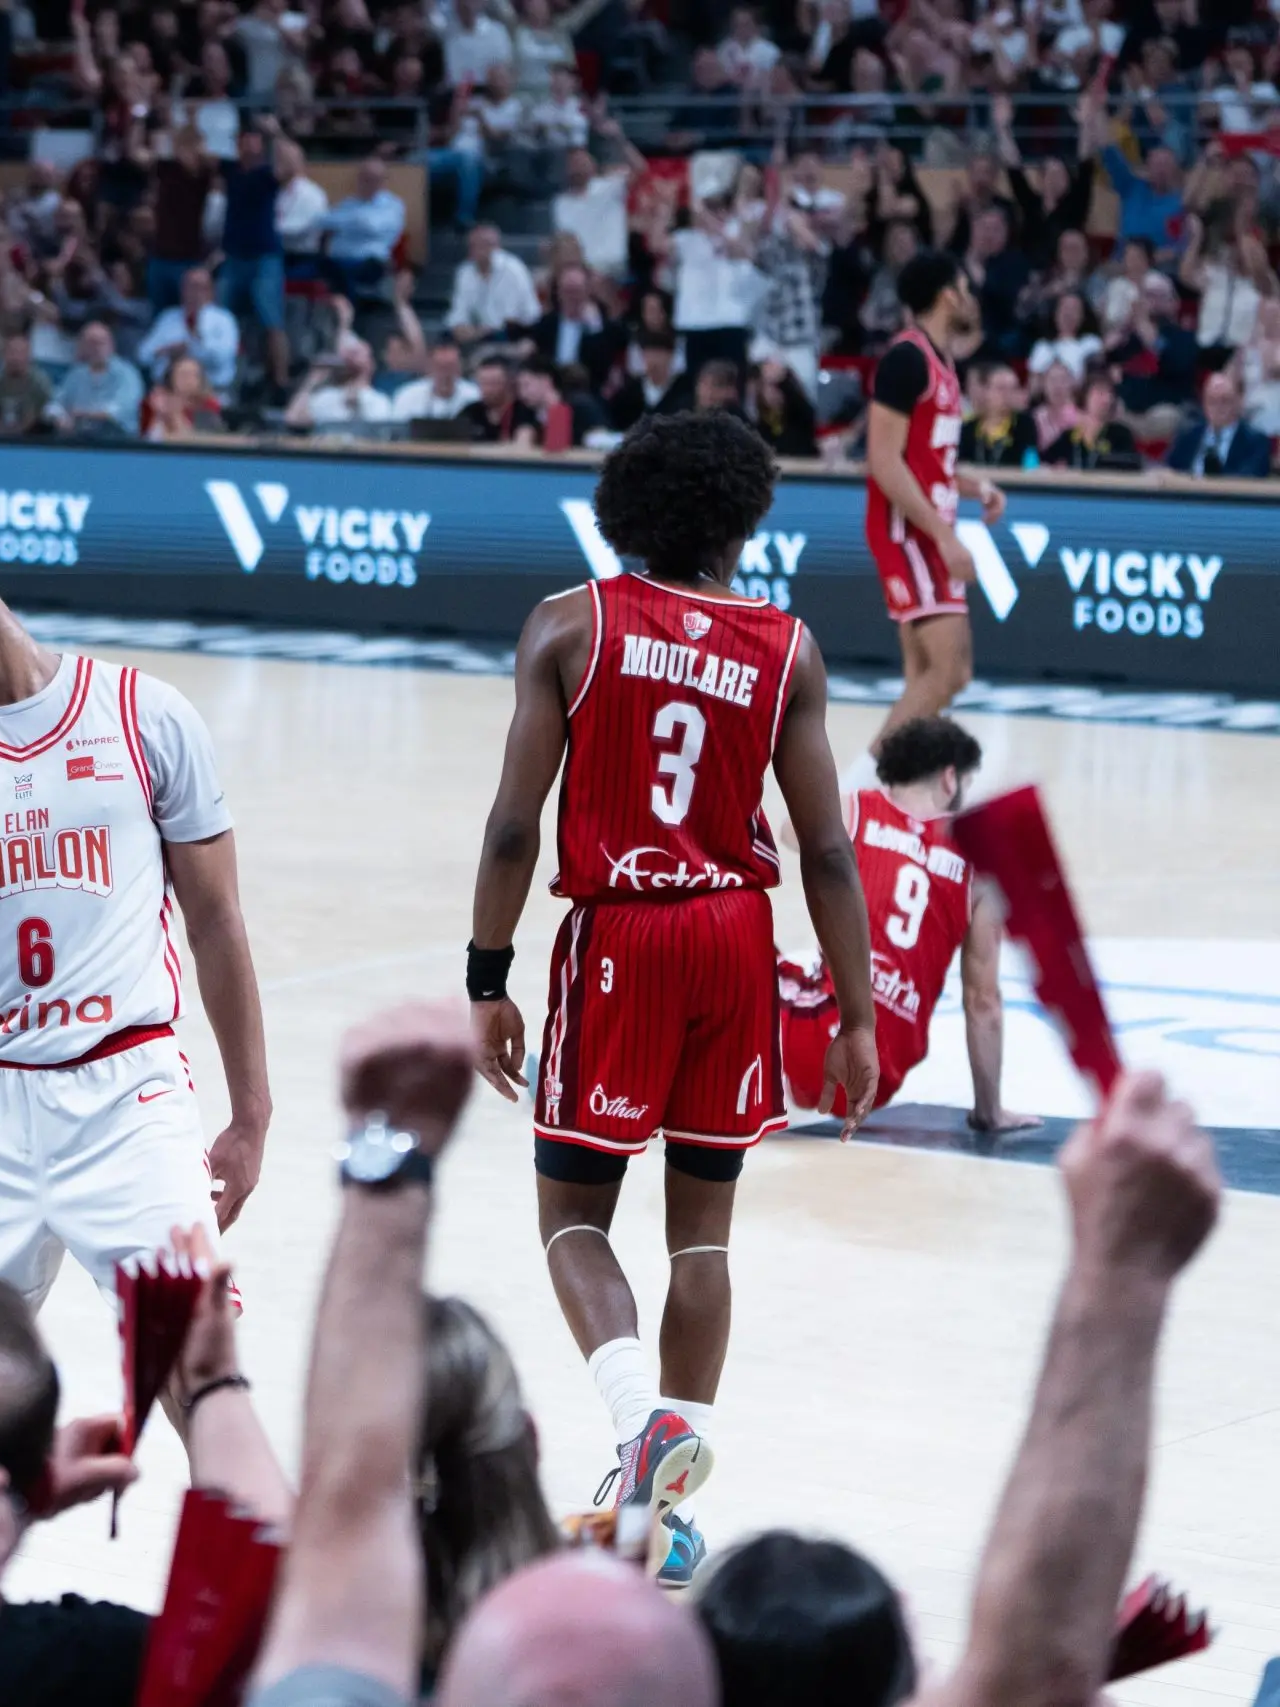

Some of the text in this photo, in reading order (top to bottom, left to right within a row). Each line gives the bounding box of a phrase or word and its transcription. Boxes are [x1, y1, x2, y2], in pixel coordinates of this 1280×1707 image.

[294, 505, 431, 553] VICKY
[306, 547, 417, 588] FOODS
[1059, 545, 1223, 601] VICKY
[1073, 595, 1205, 639] FOODS
[621, 634, 759, 709] MOULARE
[82, 736, 119, 747] PAPREC
[650, 701, 707, 827] 3
[5, 808, 49, 834] ELAN
[885, 864, 930, 950] 9
[17, 917, 56, 989] 6
[600, 957, 614, 994] 3
